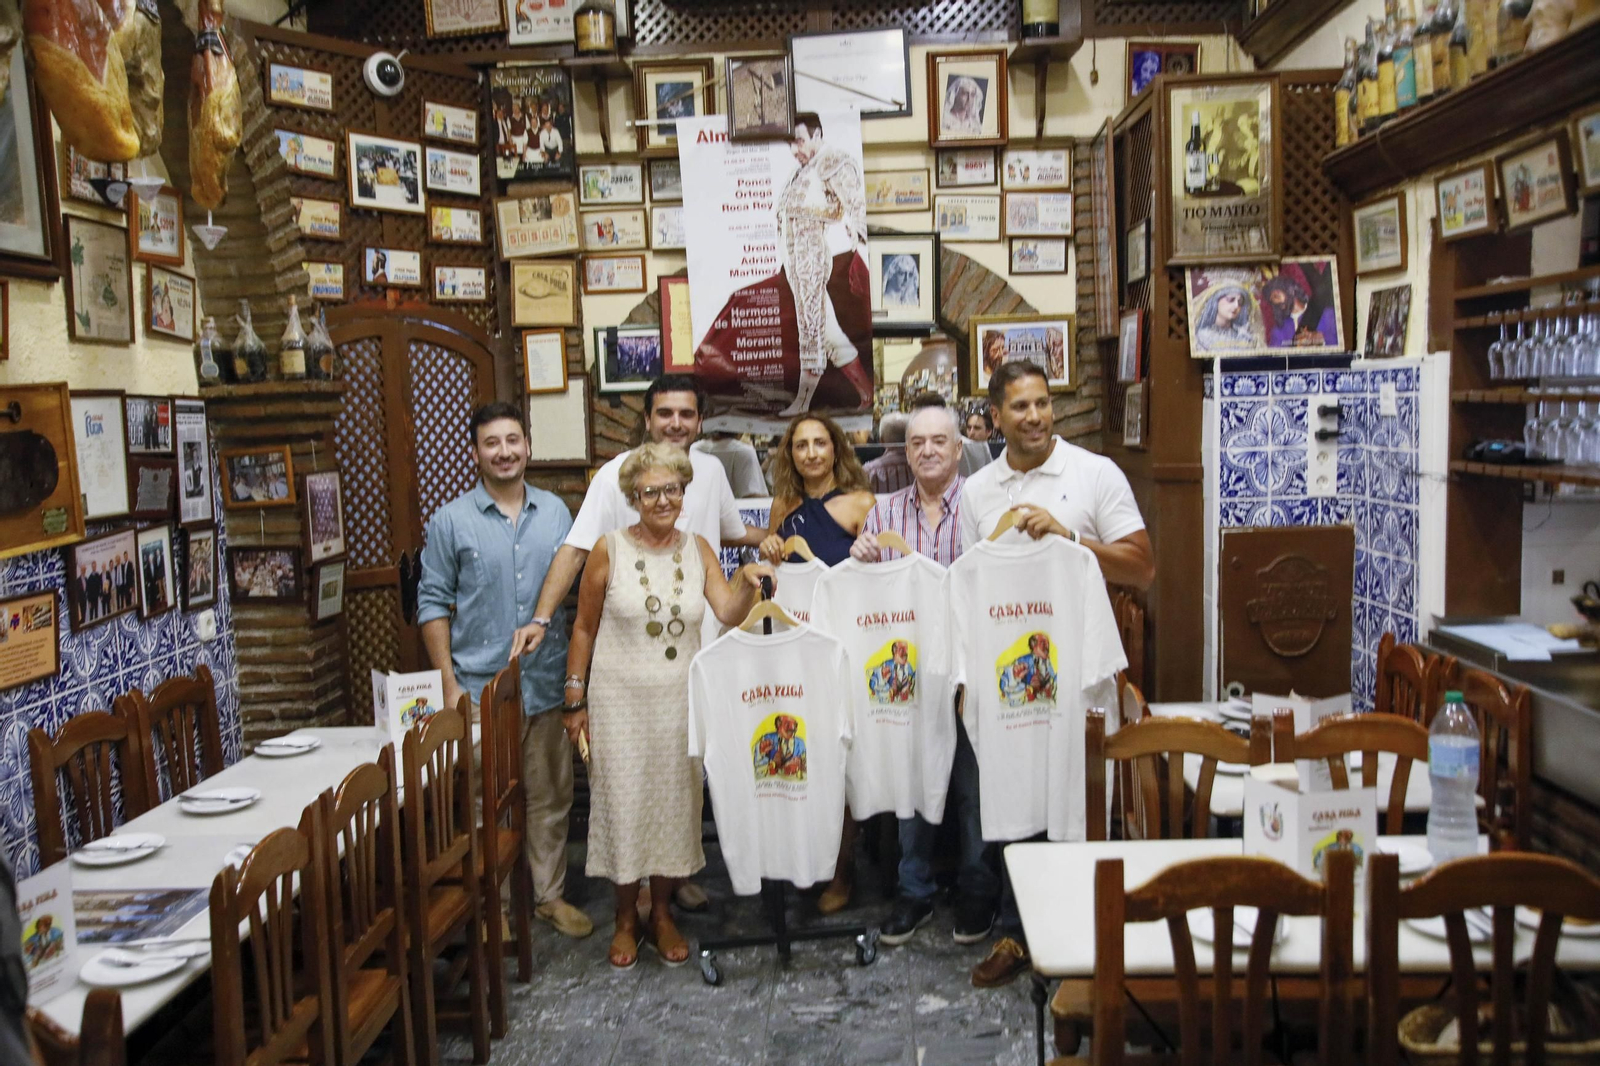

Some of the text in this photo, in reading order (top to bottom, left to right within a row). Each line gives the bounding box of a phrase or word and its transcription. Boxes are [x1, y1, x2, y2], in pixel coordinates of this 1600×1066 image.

[496, 69, 562, 86] Semana Santa
[521, 86, 541, 97] 2010
[737, 178, 772, 188] Ponce
[735, 190, 772, 200] Ortega
[722, 201, 773, 212] Roca Rey
[1183, 204, 1260, 219] TIO MATEO
[743, 244, 776, 254] Ureña
[741, 256, 777, 266] Adrián
[730, 306, 780, 318] Hermoso
[714, 316, 781, 330] de Mendoza
[736, 336, 782, 348] Morante
[731, 350, 783, 362] Talavante
[989, 602, 1024, 620] CASA
[857, 612, 889, 627] CASA
[742, 684, 804, 703] CASA PUGA
